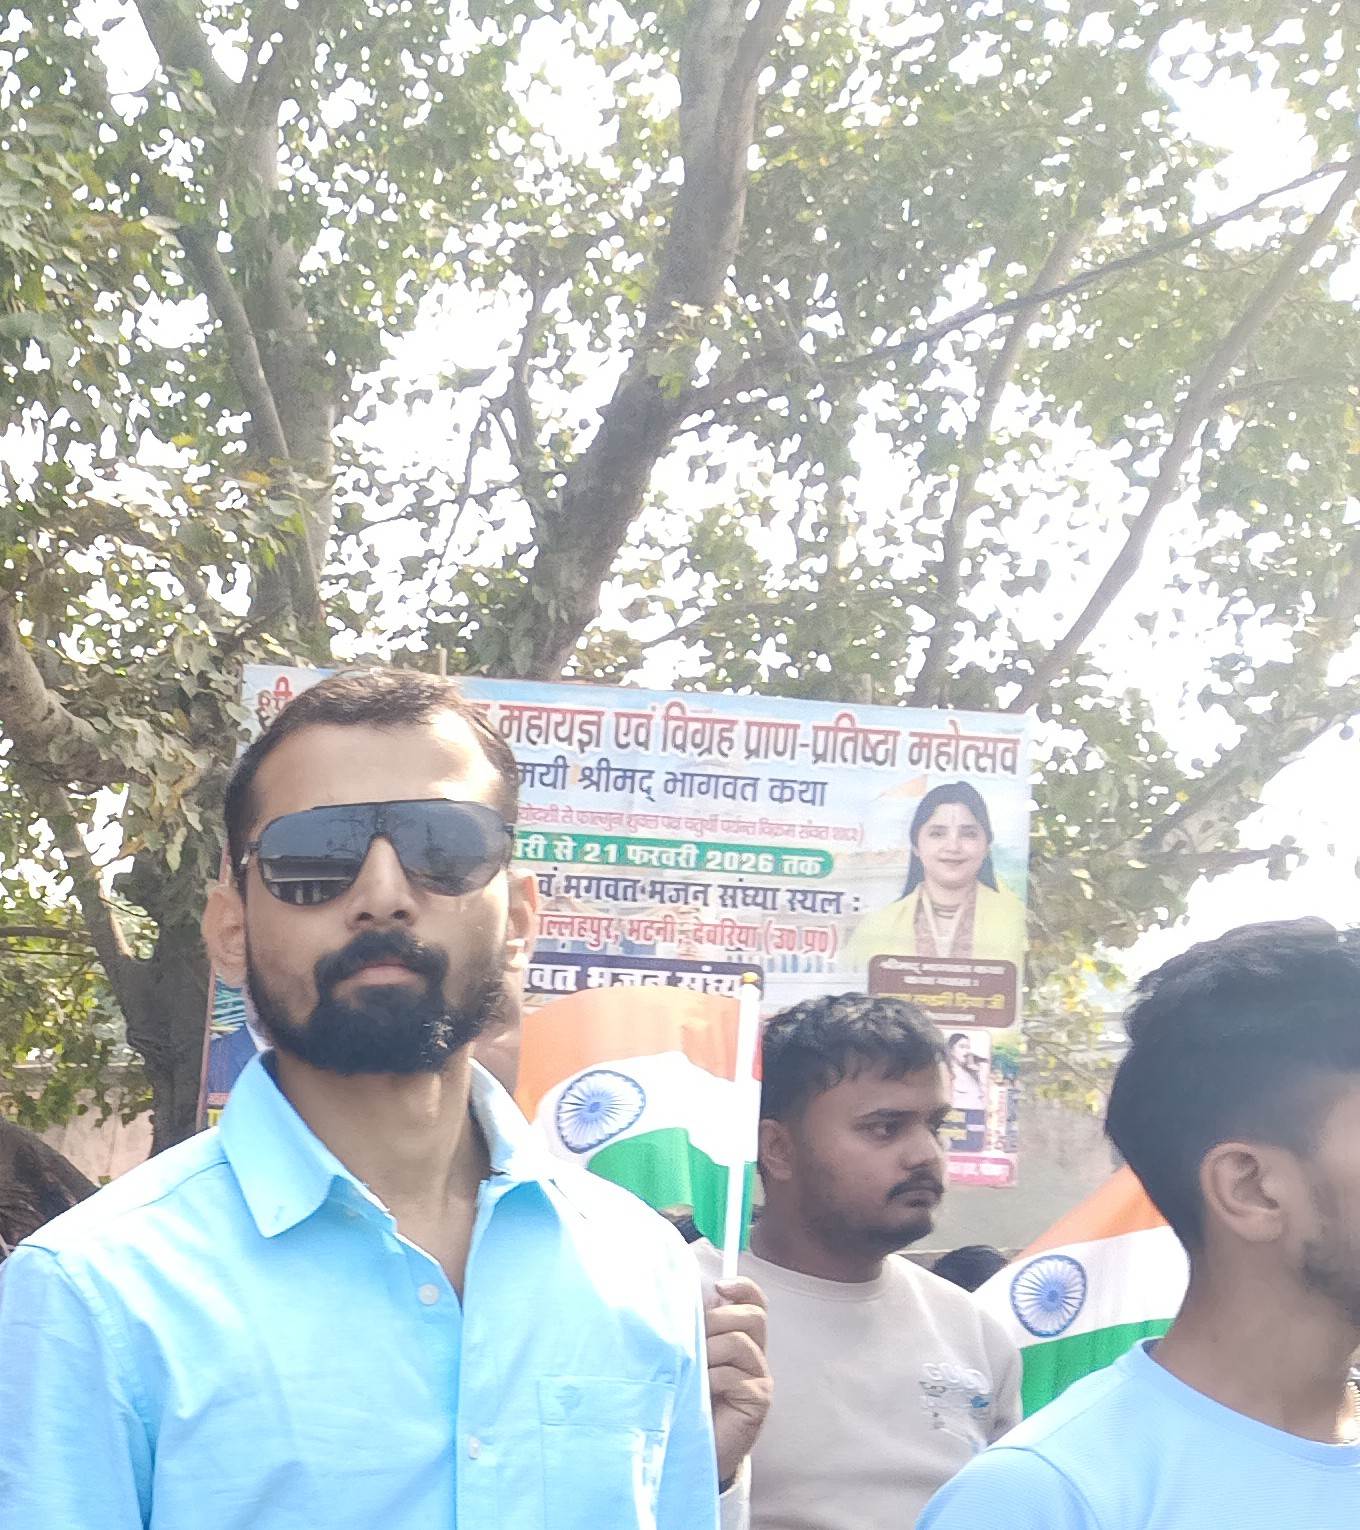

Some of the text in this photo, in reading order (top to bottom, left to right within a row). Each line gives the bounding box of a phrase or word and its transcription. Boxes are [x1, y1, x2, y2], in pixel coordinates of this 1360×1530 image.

[498, 703, 605, 754] महायज्ञ
[614, 705, 657, 750] एवं
[662, 701, 739, 758] विग्रह
[907, 719, 1021, 775] महोत्सव
[516, 755, 829, 807] मयी श्रीमद् भागवत कथा
[552, 836, 578, 861] से
[583, 843, 619, 863] 21
[625, 843, 700, 868] फरवरी
[705, 850, 775, 873] 2026
[781, 854, 826, 876] तक
[536, 866, 558, 897] वं
[538, 913, 621, 948] ल्लहपुर,
[525, 963, 582, 992] वत
